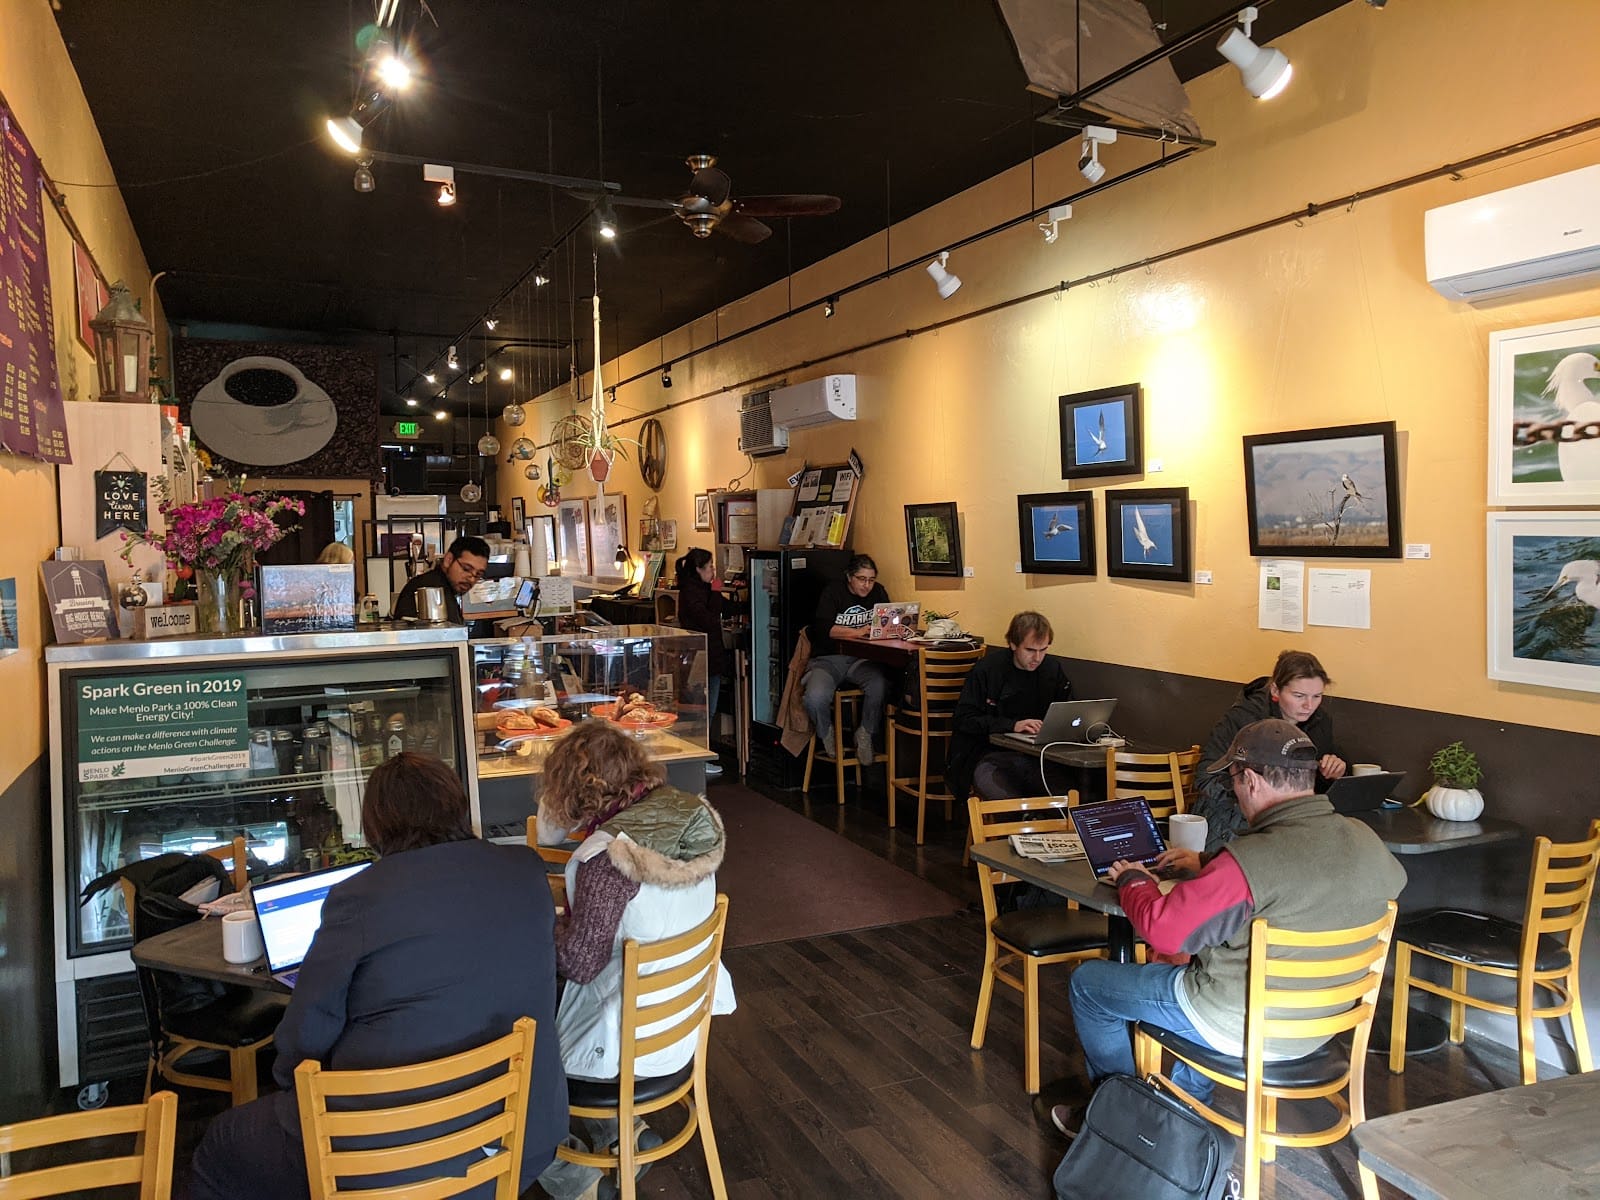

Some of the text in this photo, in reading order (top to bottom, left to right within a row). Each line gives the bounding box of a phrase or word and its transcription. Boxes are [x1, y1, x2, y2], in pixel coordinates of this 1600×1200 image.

[400, 422, 416, 434] EXIT
[104, 492, 139, 500] LOVE
[108, 501, 134, 510] lives
[104, 511, 140, 520] HERE
[150, 613, 191, 628] welcome
[82, 679, 242, 700] Spark Green in 2019
[90, 707, 117, 716] Make
[120, 704, 150, 714] Menlo
[152, 702, 173, 712] Park
[184, 702, 210, 710] 100%
[211, 699, 238, 708] Clean
[136, 710, 194, 722] Energy City!
[91, 735, 104, 743] We
[123, 732, 144, 741] make
[152, 729, 190, 739] difference
[191, 728, 208, 736] with
[210, 726, 238, 735] climate
[91, 746, 120, 755] actions
[134, 744, 147, 752] the
[148, 742, 172, 750] Menlo
[199, 738, 238, 748] Challenge.
[190, 752, 246, 762] #SparkGreen2019
